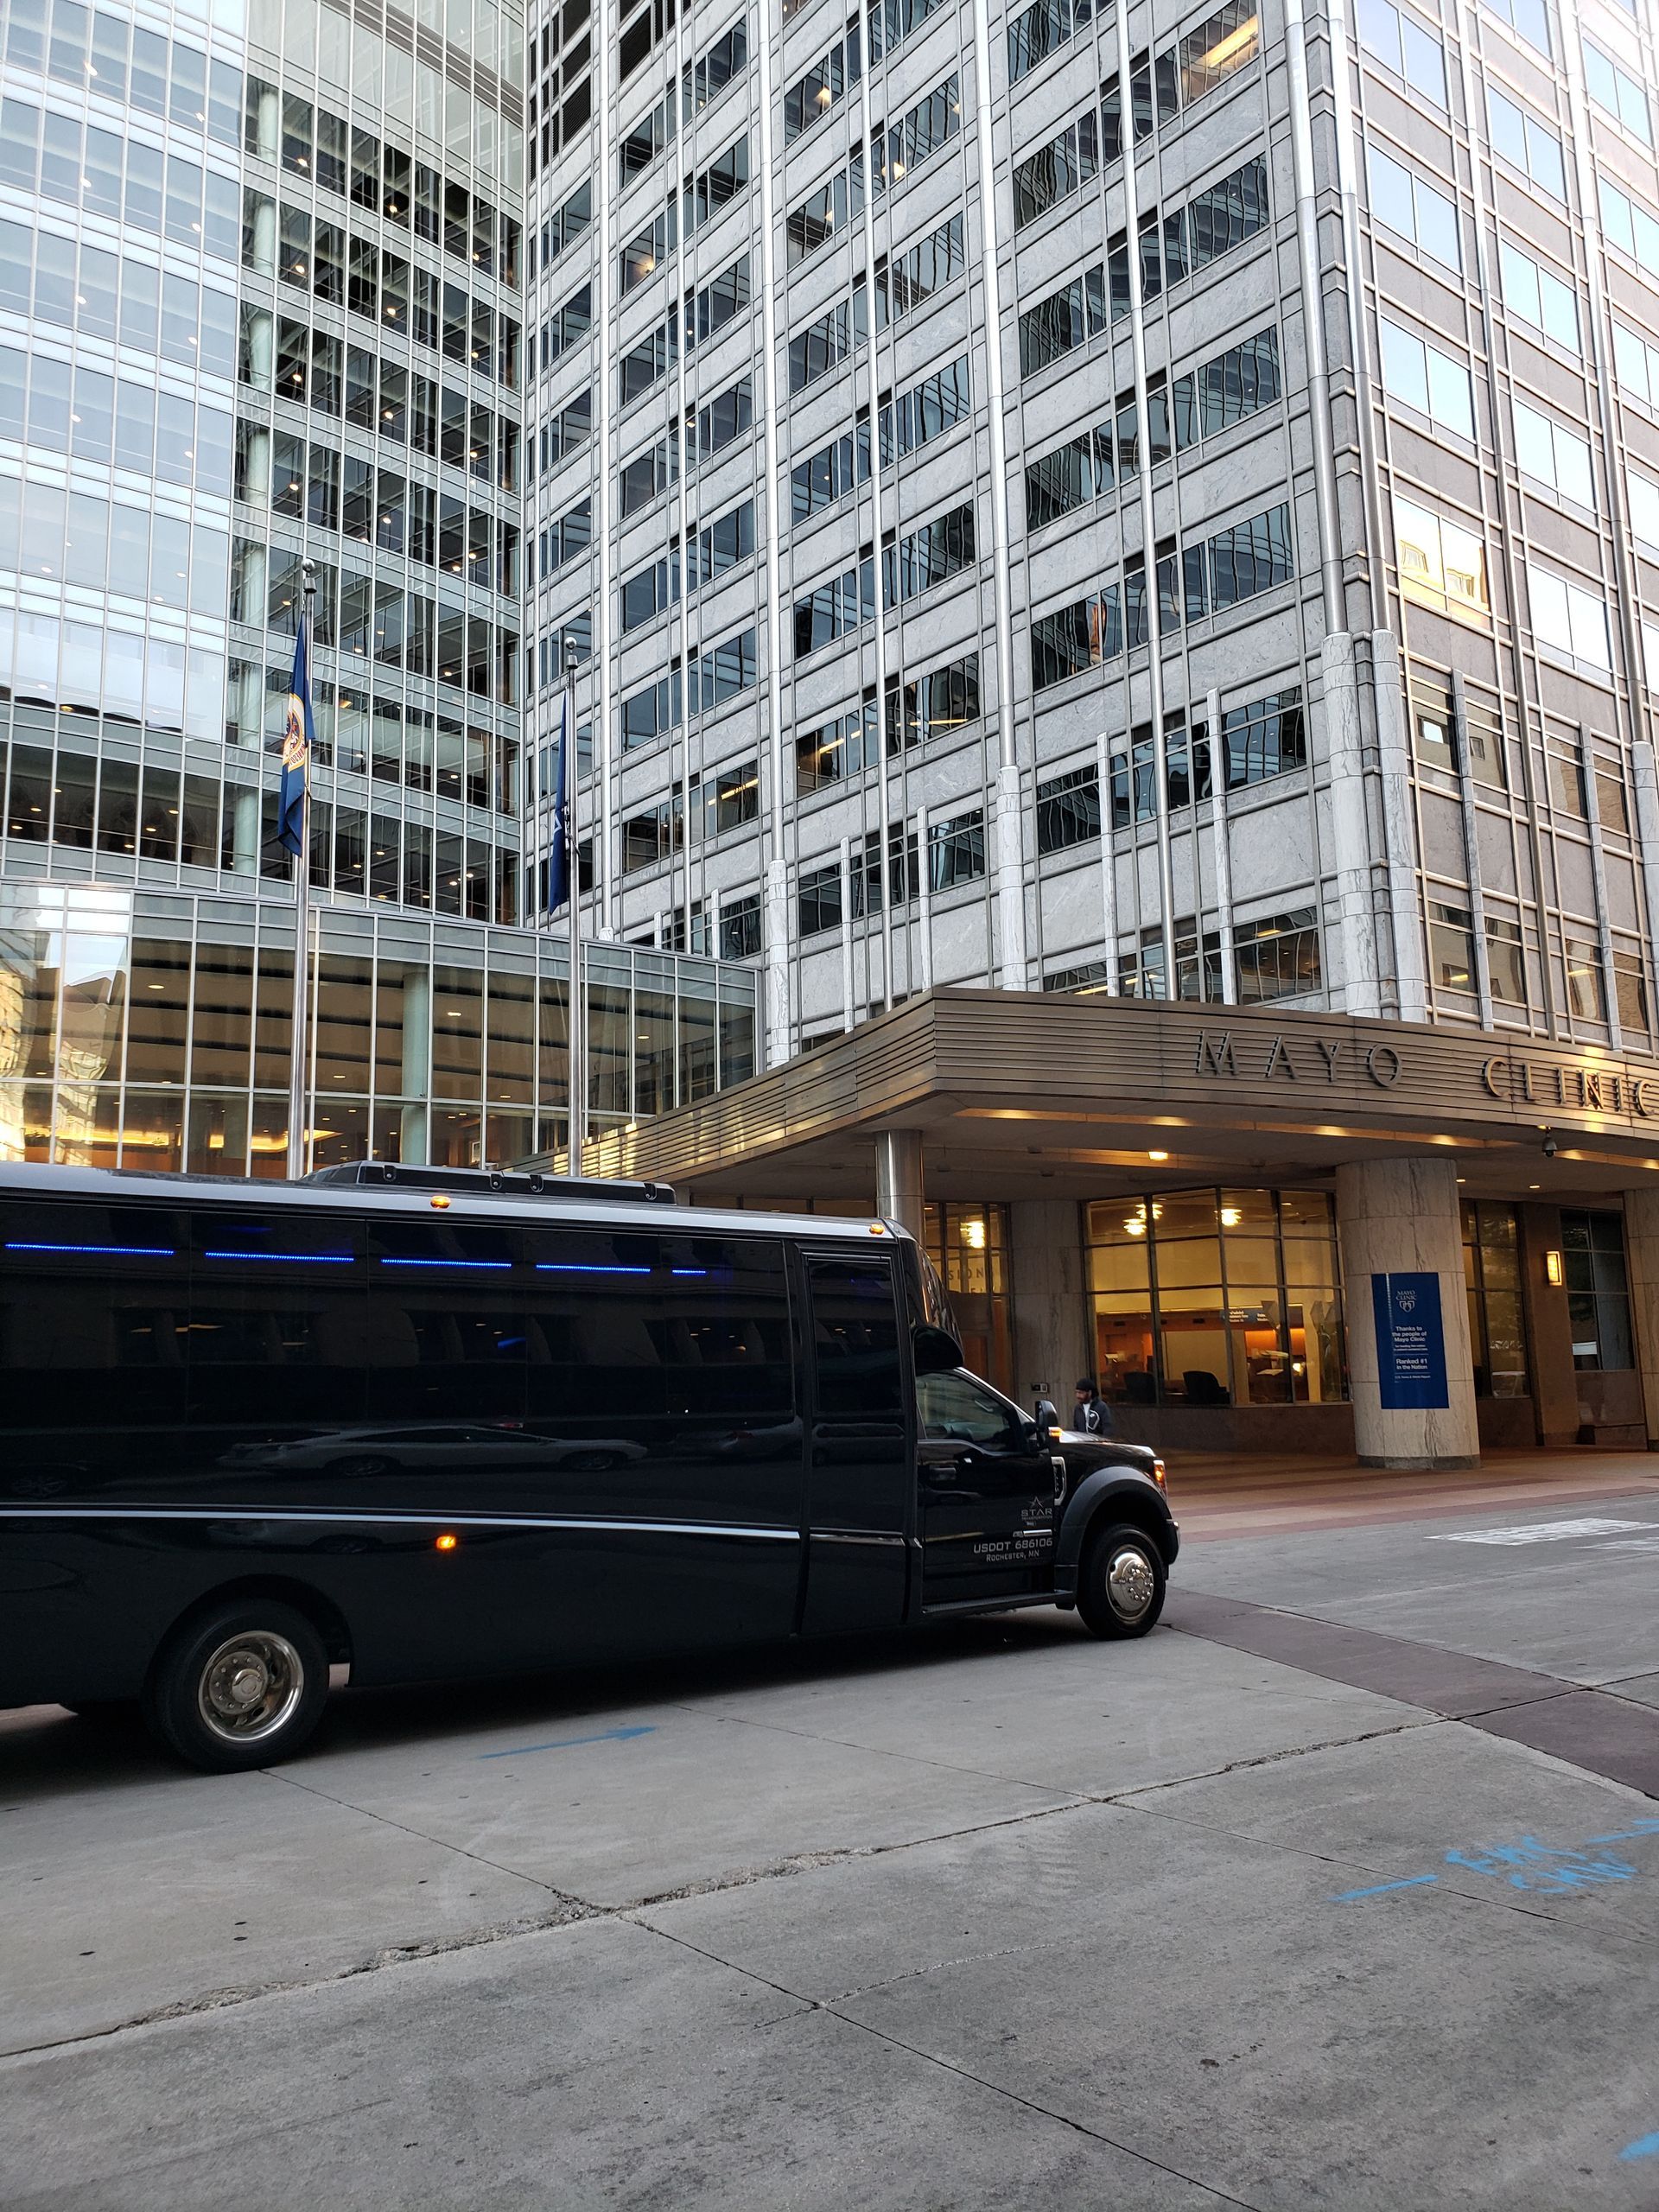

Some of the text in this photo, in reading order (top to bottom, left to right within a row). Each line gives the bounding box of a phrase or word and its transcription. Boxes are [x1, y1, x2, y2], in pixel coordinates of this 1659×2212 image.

[1197, 1029, 1656, 1117] MAYO CLINIC
[1021, 1508, 1052, 1516] STAR
[974, 1538, 1052, 1554] USDOT 686106
